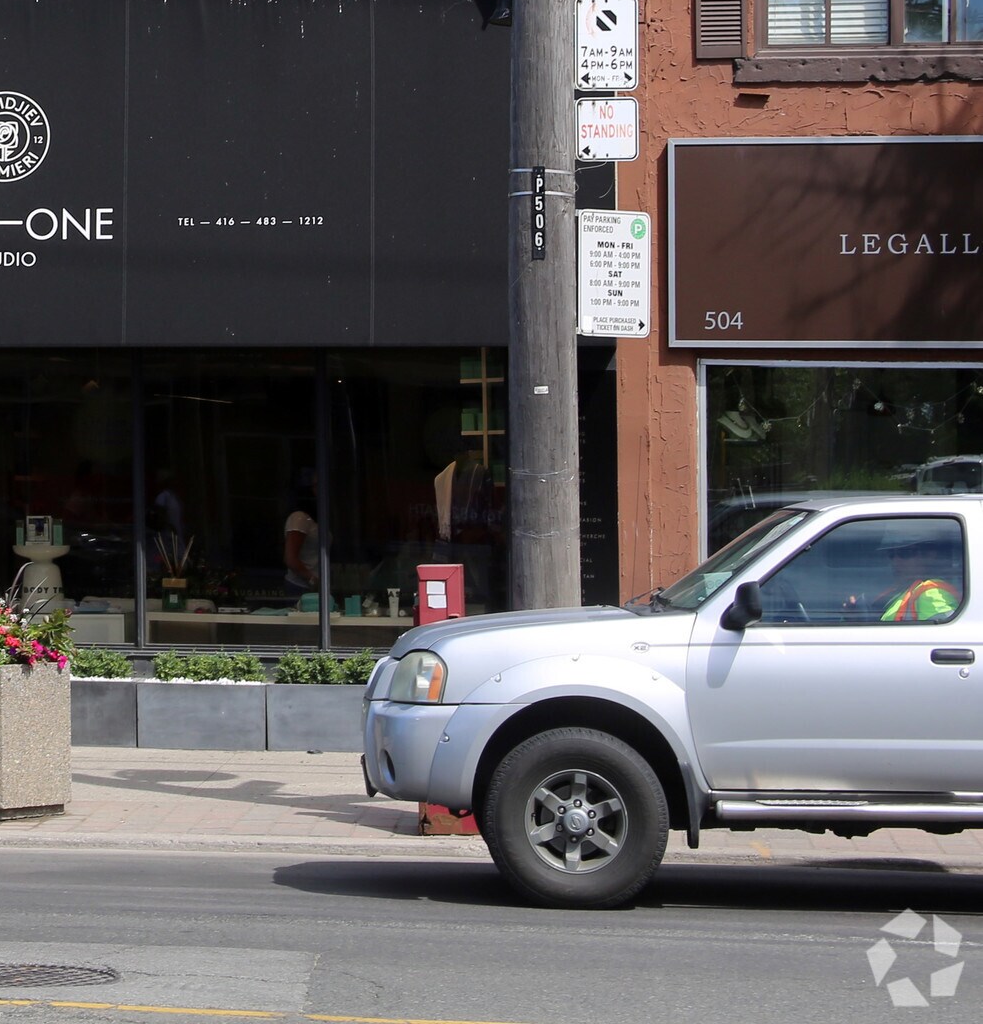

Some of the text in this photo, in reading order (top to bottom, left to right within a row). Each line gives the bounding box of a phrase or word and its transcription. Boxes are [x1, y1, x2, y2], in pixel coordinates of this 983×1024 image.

[599, 105, 614, 120] NO
[581, 124, 634, 138] STANDING
[34, 136, 44, 144] 12
[177, 217, 195, 226] TEL
[215, 217, 235, 226] 416
[256, 217, 277, 226] 483
[299, 216, 324, 225] 1212
[595, 216, 622, 224] PARKING
[583, 225, 614, 234] ENFORCED
[622, 242, 634, 250] FRI
[590, 250, 602, 258] 9:00
[632, 252, 640, 260] PM
[590, 260, 602, 268] 6:00
[631, 262, 640, 270] PM
[590, 298, 602, 306] 1:00
[593, 316, 608, 324] PLACE
[704, 311, 743, 330] 504
[596, 324, 613, 332] TICKET
[24, 586, 49, 594] BODY
